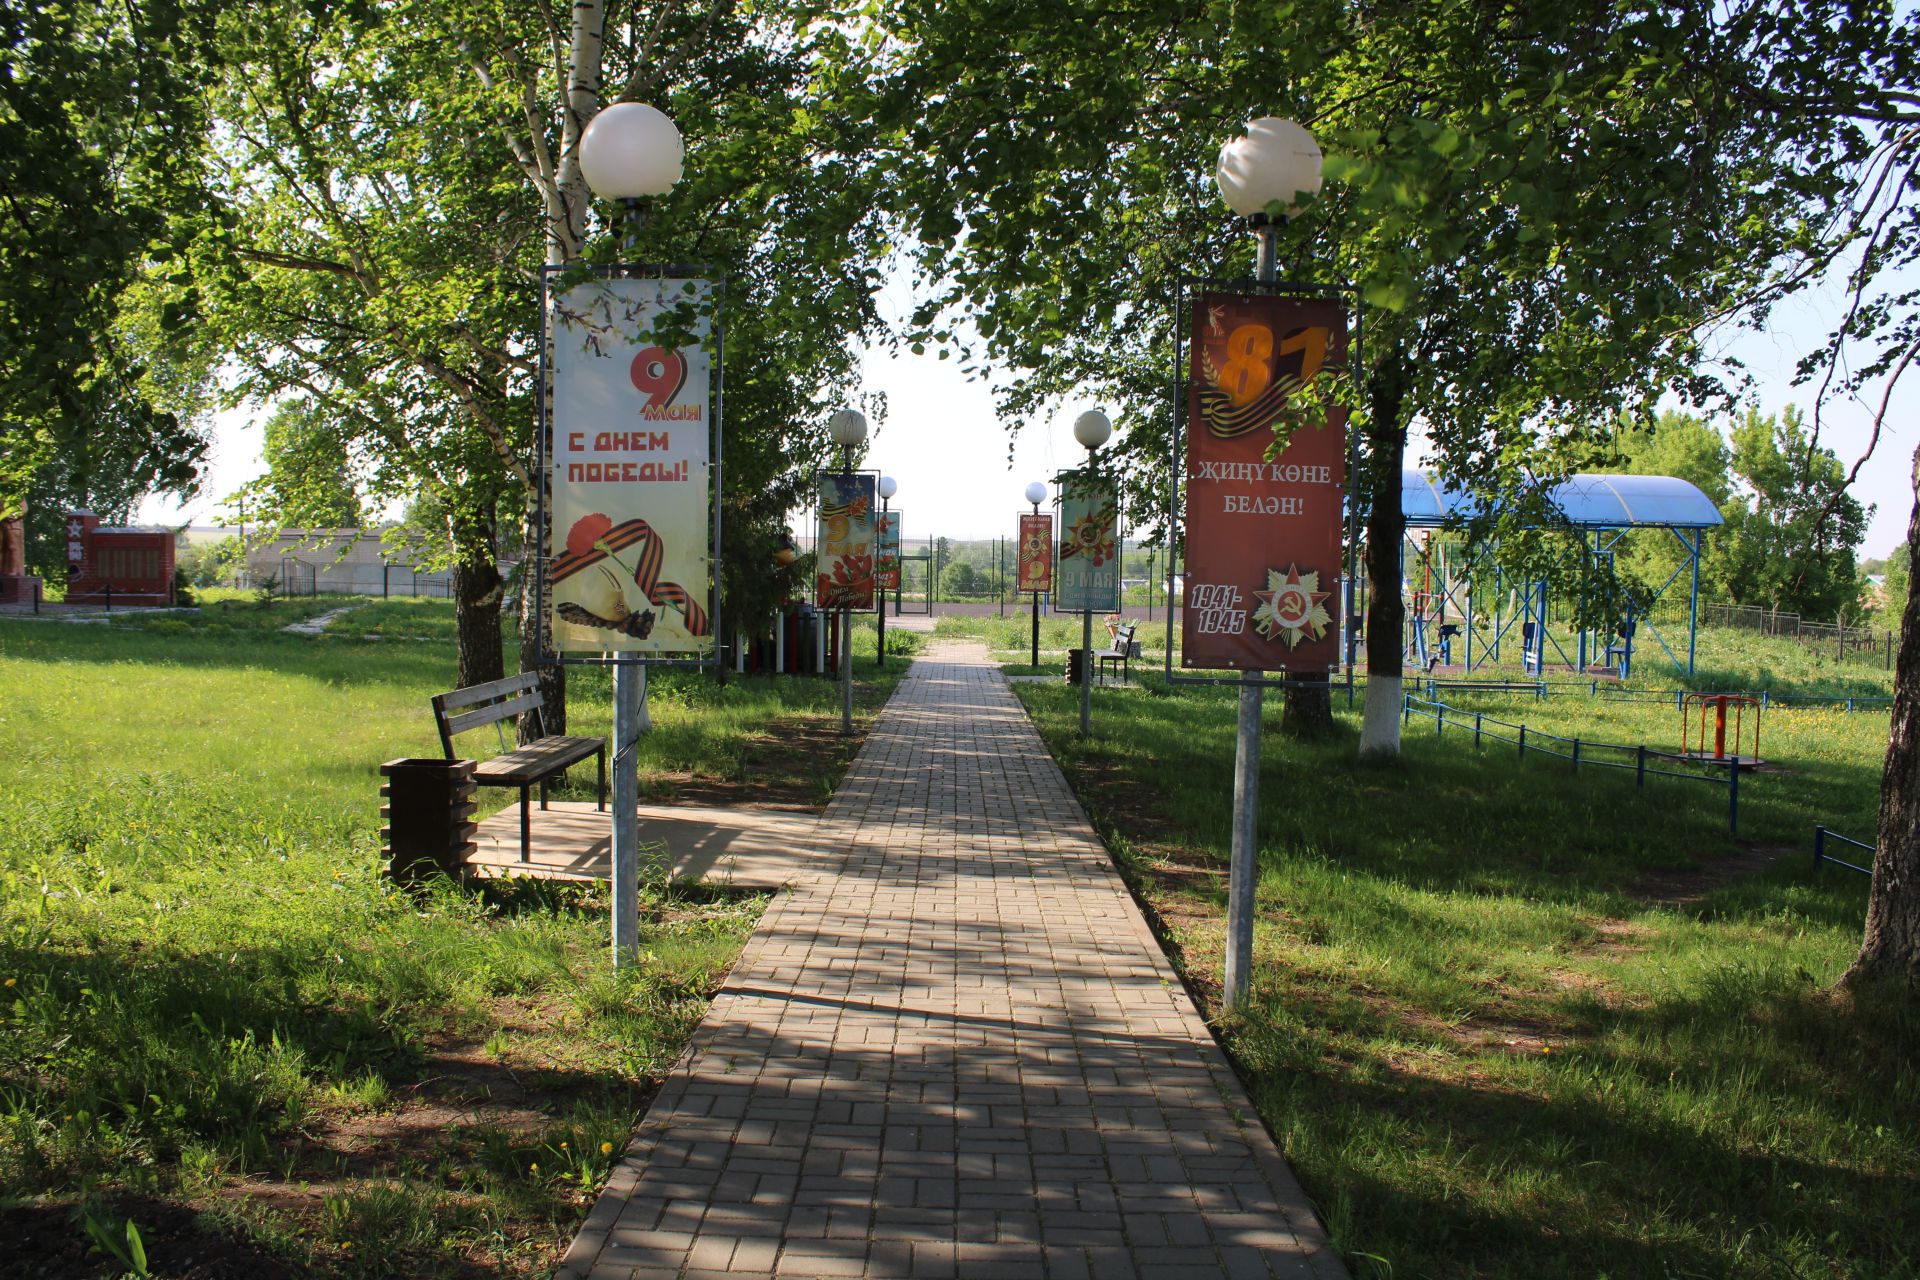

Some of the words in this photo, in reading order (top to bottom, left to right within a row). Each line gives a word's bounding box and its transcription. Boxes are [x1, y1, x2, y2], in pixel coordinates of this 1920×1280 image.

[630, 346, 688, 412] 9
[568, 432, 584, 451] С
[593, 431, 668, 451] ДНЕМ
[568, 459, 688, 482] ПОБЕДЫ!
[1197, 461, 1267, 485] ЖИҢҮ
[1270, 464, 1331, 484] КӨНЕ
[1223, 495, 1304, 516] БЕЛӘН!
[826, 514, 849, 542] 9
[825, 543, 867, 556] МАЯ
[1027, 561, 1044, 579] 9
[1065, 571, 1075, 588] 9
[1079, 571, 1113, 589] МАЯ
[1191, 584, 1242, 610] 1941-
[1198, 608, 1247, 635] 1945
